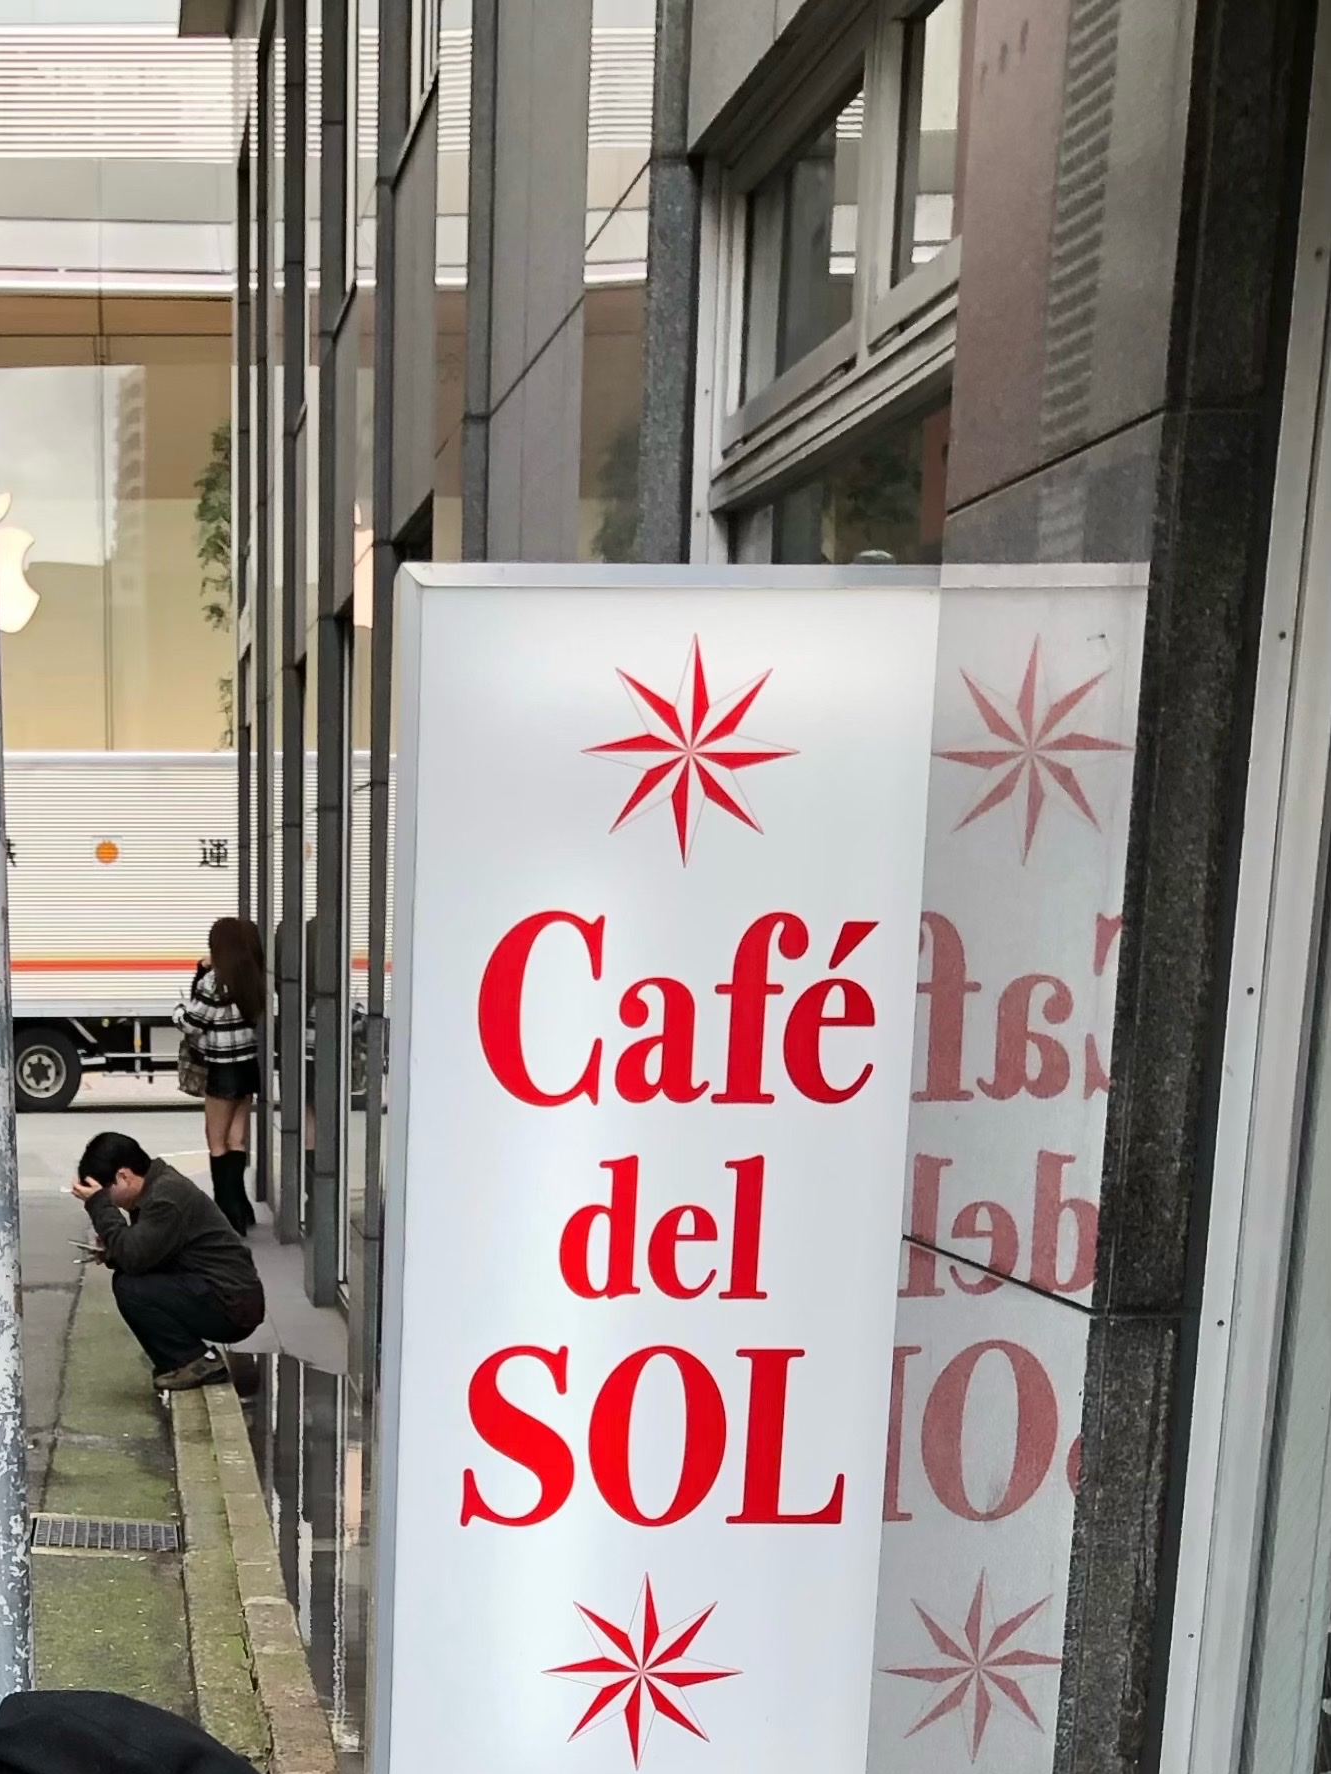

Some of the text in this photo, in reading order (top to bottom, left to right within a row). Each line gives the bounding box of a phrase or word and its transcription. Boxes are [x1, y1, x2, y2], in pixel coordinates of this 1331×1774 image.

[198, 837, 229, 869] 運
[477, 909, 877, 1108] Café
[558, 1153, 767, 1300] del
[460, 1344, 845, 1528] SOL
